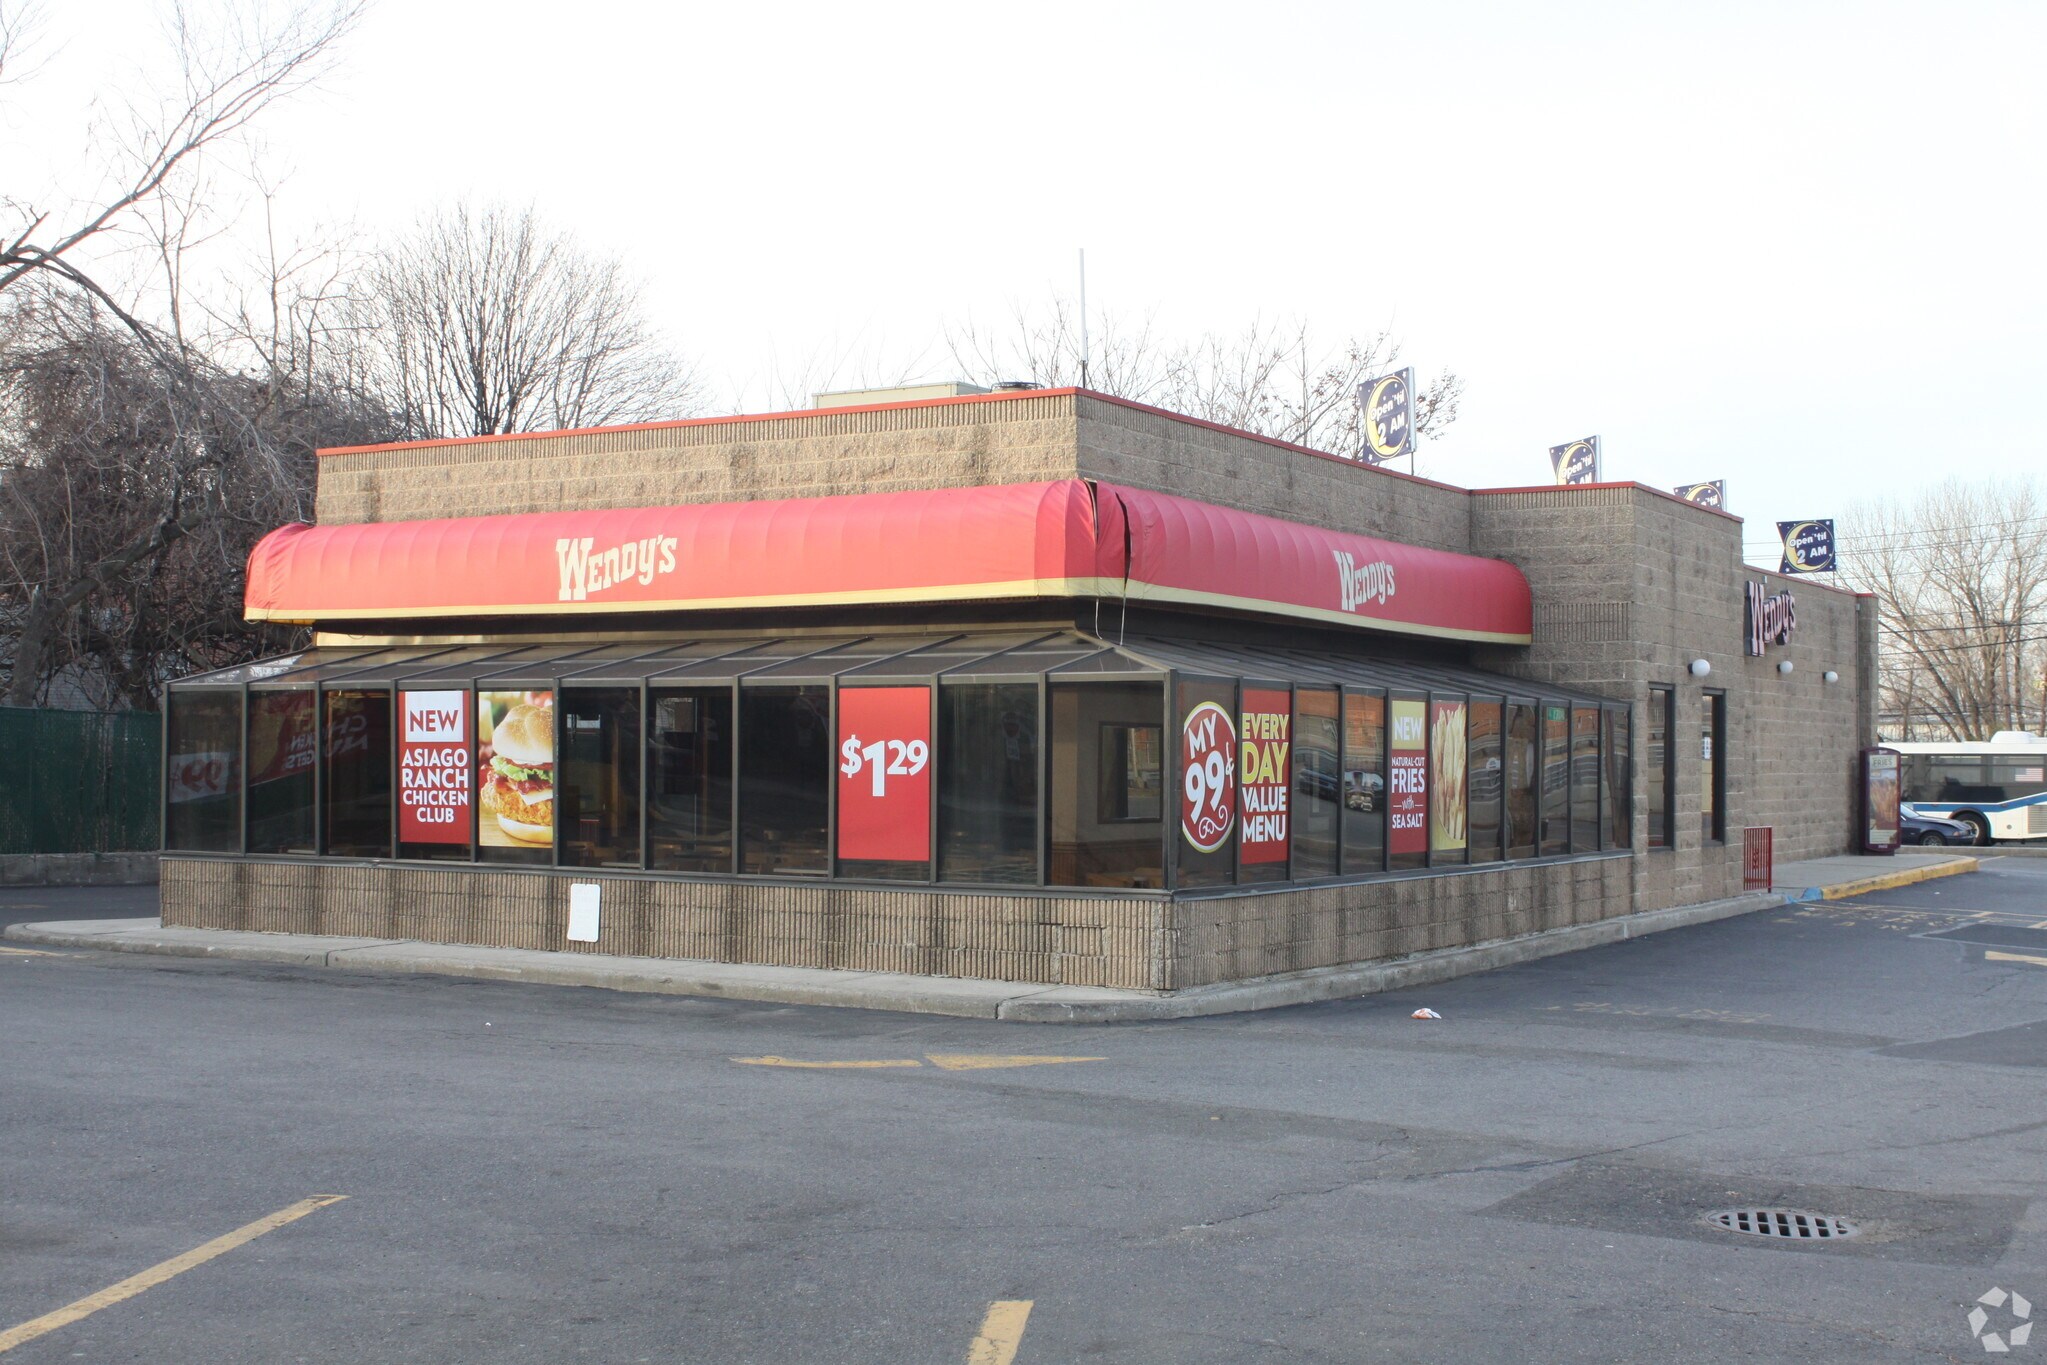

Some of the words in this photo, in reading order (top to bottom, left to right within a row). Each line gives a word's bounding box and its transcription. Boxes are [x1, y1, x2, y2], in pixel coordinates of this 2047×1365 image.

[1370, 400, 1394, 421] Open
[1377, 422, 1386, 448] 2
[1390, 412, 1405, 434] AM
[1789, 536, 1813, 549] Open
[556, 534, 678, 600] Wendy's
[1796, 549, 1806, 565] 2
[1810, 545, 1827, 558] AM
[1333, 550, 1395, 612] Wendy's
[409, 709, 459, 734] NEW
[1242, 713, 1289, 740] EVERY
[1394, 717, 1422, 741] NEW
[1188, 713, 1218, 759] MY
[402, 748, 468, 768] ASIAGO
[1242, 742, 1288, 784] DAY
[1392, 757, 1425, 766] NATURAL-CUT
[402, 768, 468, 788] RANCH
[1392, 768, 1425, 793] FRIES
[402, 790, 468, 806] CHICKEN
[1242, 786, 1287, 813] VALUE
[416, 807, 455, 823] CLUB
[1392, 814, 1406, 829] SEA
[1407, 813, 1424, 828] SALT
[1242, 815, 1286, 843] MENU
